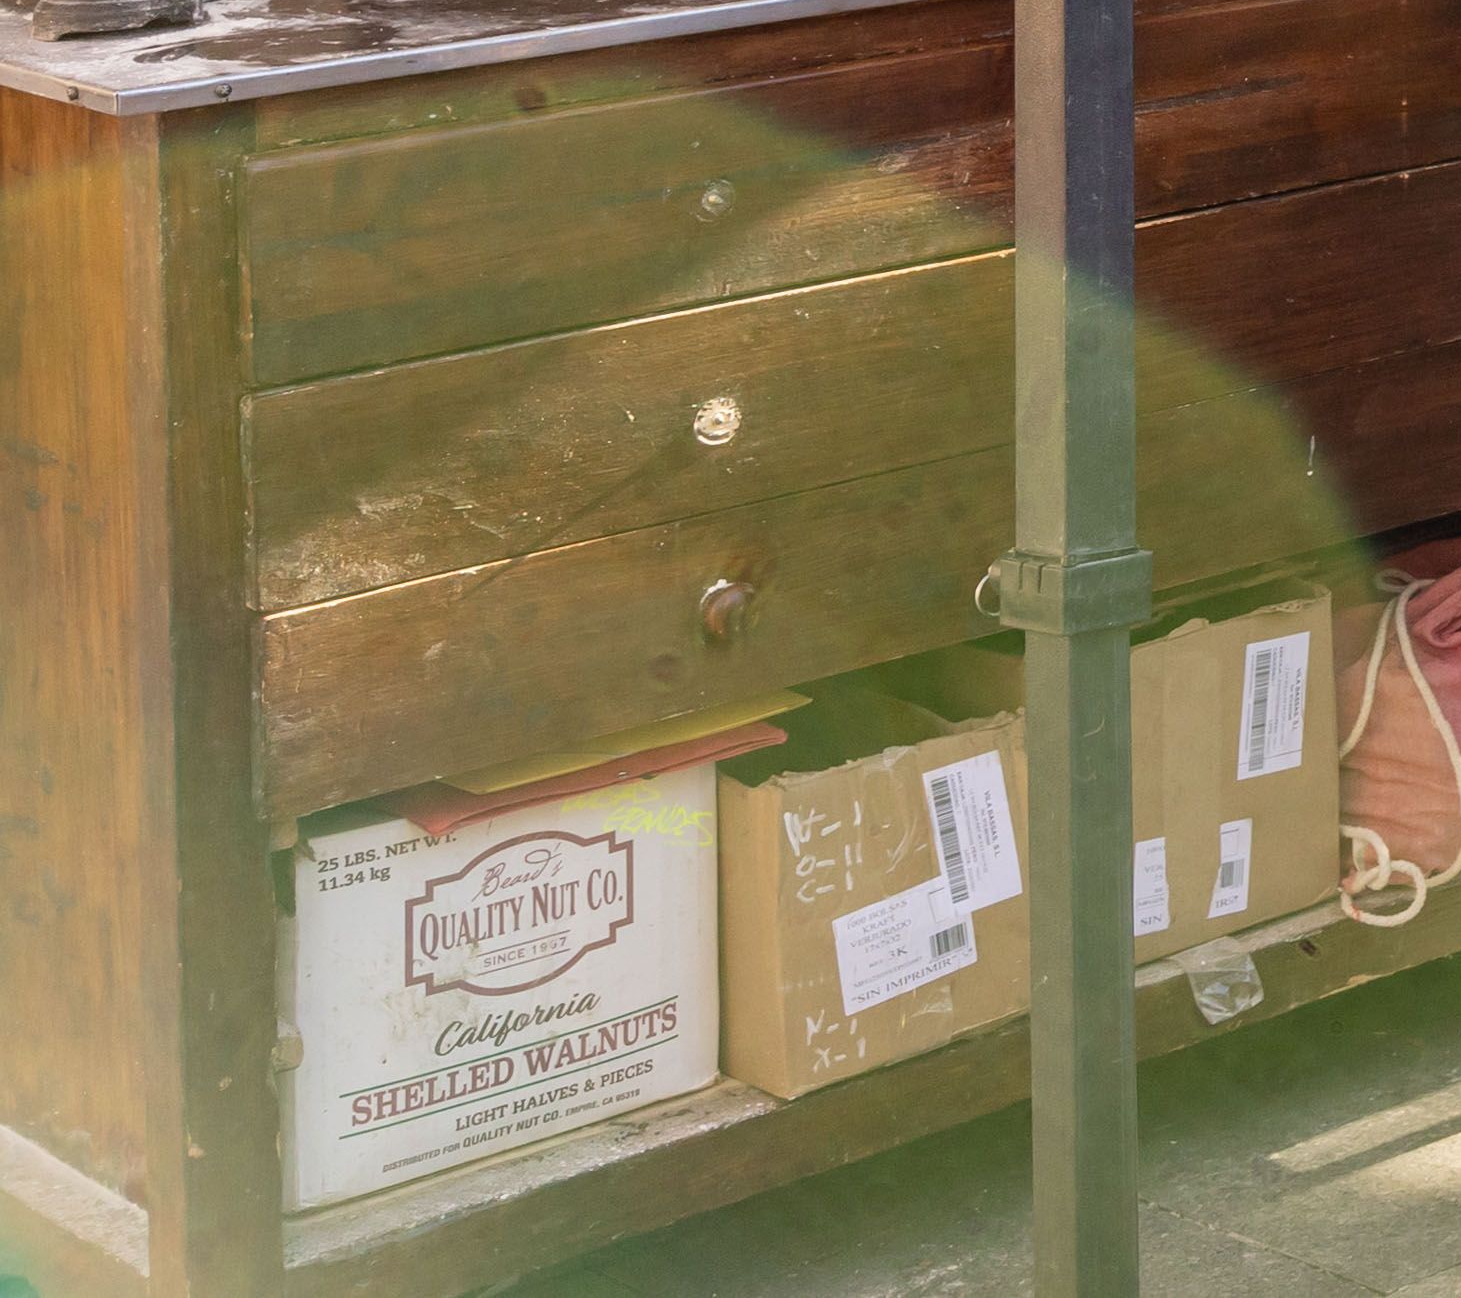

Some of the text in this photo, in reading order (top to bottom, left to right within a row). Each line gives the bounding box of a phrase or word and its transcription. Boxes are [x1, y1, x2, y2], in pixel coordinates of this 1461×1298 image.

[318, 857, 339, 873] 25
[344, 850, 382, 869] LBS.
[384, 840, 418, 860] NET
[318, 866, 391, 892] 11.34 kg
[419, 868, 624, 961] QUALITY NUT CO.
[484, 948, 526, 968] SINCE
[434, 992, 602, 1057] California
[351, 1001, 678, 1127] SHELLED WALNUTS
[455, 1059, 655, 1132] LIGHT HALVES & PIECES
[382, 1149, 441, 1173] DISTRIBUTED
[442, 1141, 461, 1156] FOR
[462, 1123, 513, 1148] QUALITY
[516, 1115, 541, 1133] NUT
[542, 1109, 563, 1125] CO.
